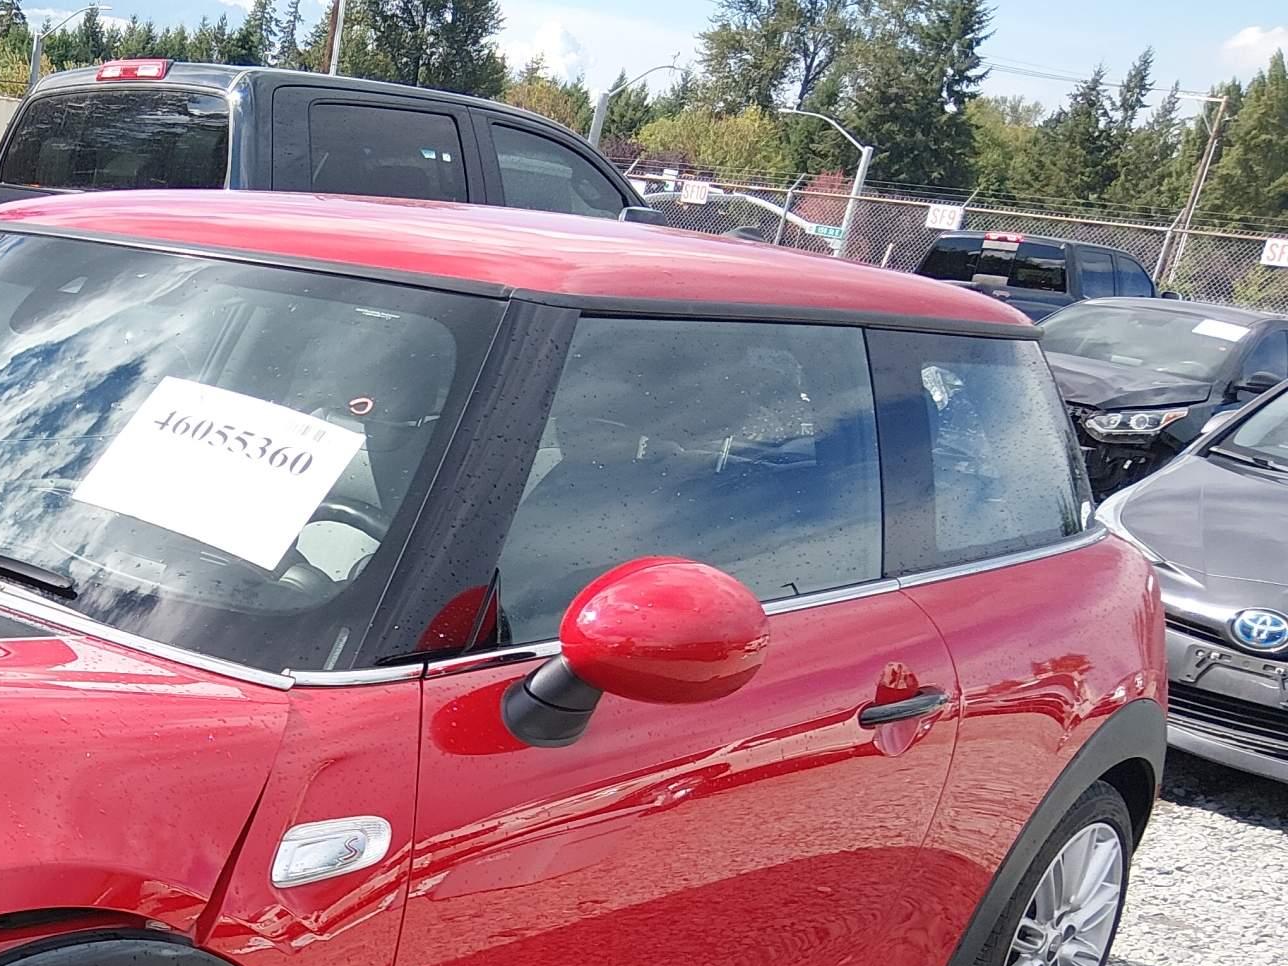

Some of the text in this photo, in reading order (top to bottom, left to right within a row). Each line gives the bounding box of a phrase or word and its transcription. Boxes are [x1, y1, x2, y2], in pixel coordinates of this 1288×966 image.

[683, 183, 707, 200] SF10
[930, 207, 956, 226] SF9
[1266, 242, 1288, 262] SF
[154, 410, 313, 476] 46055360
